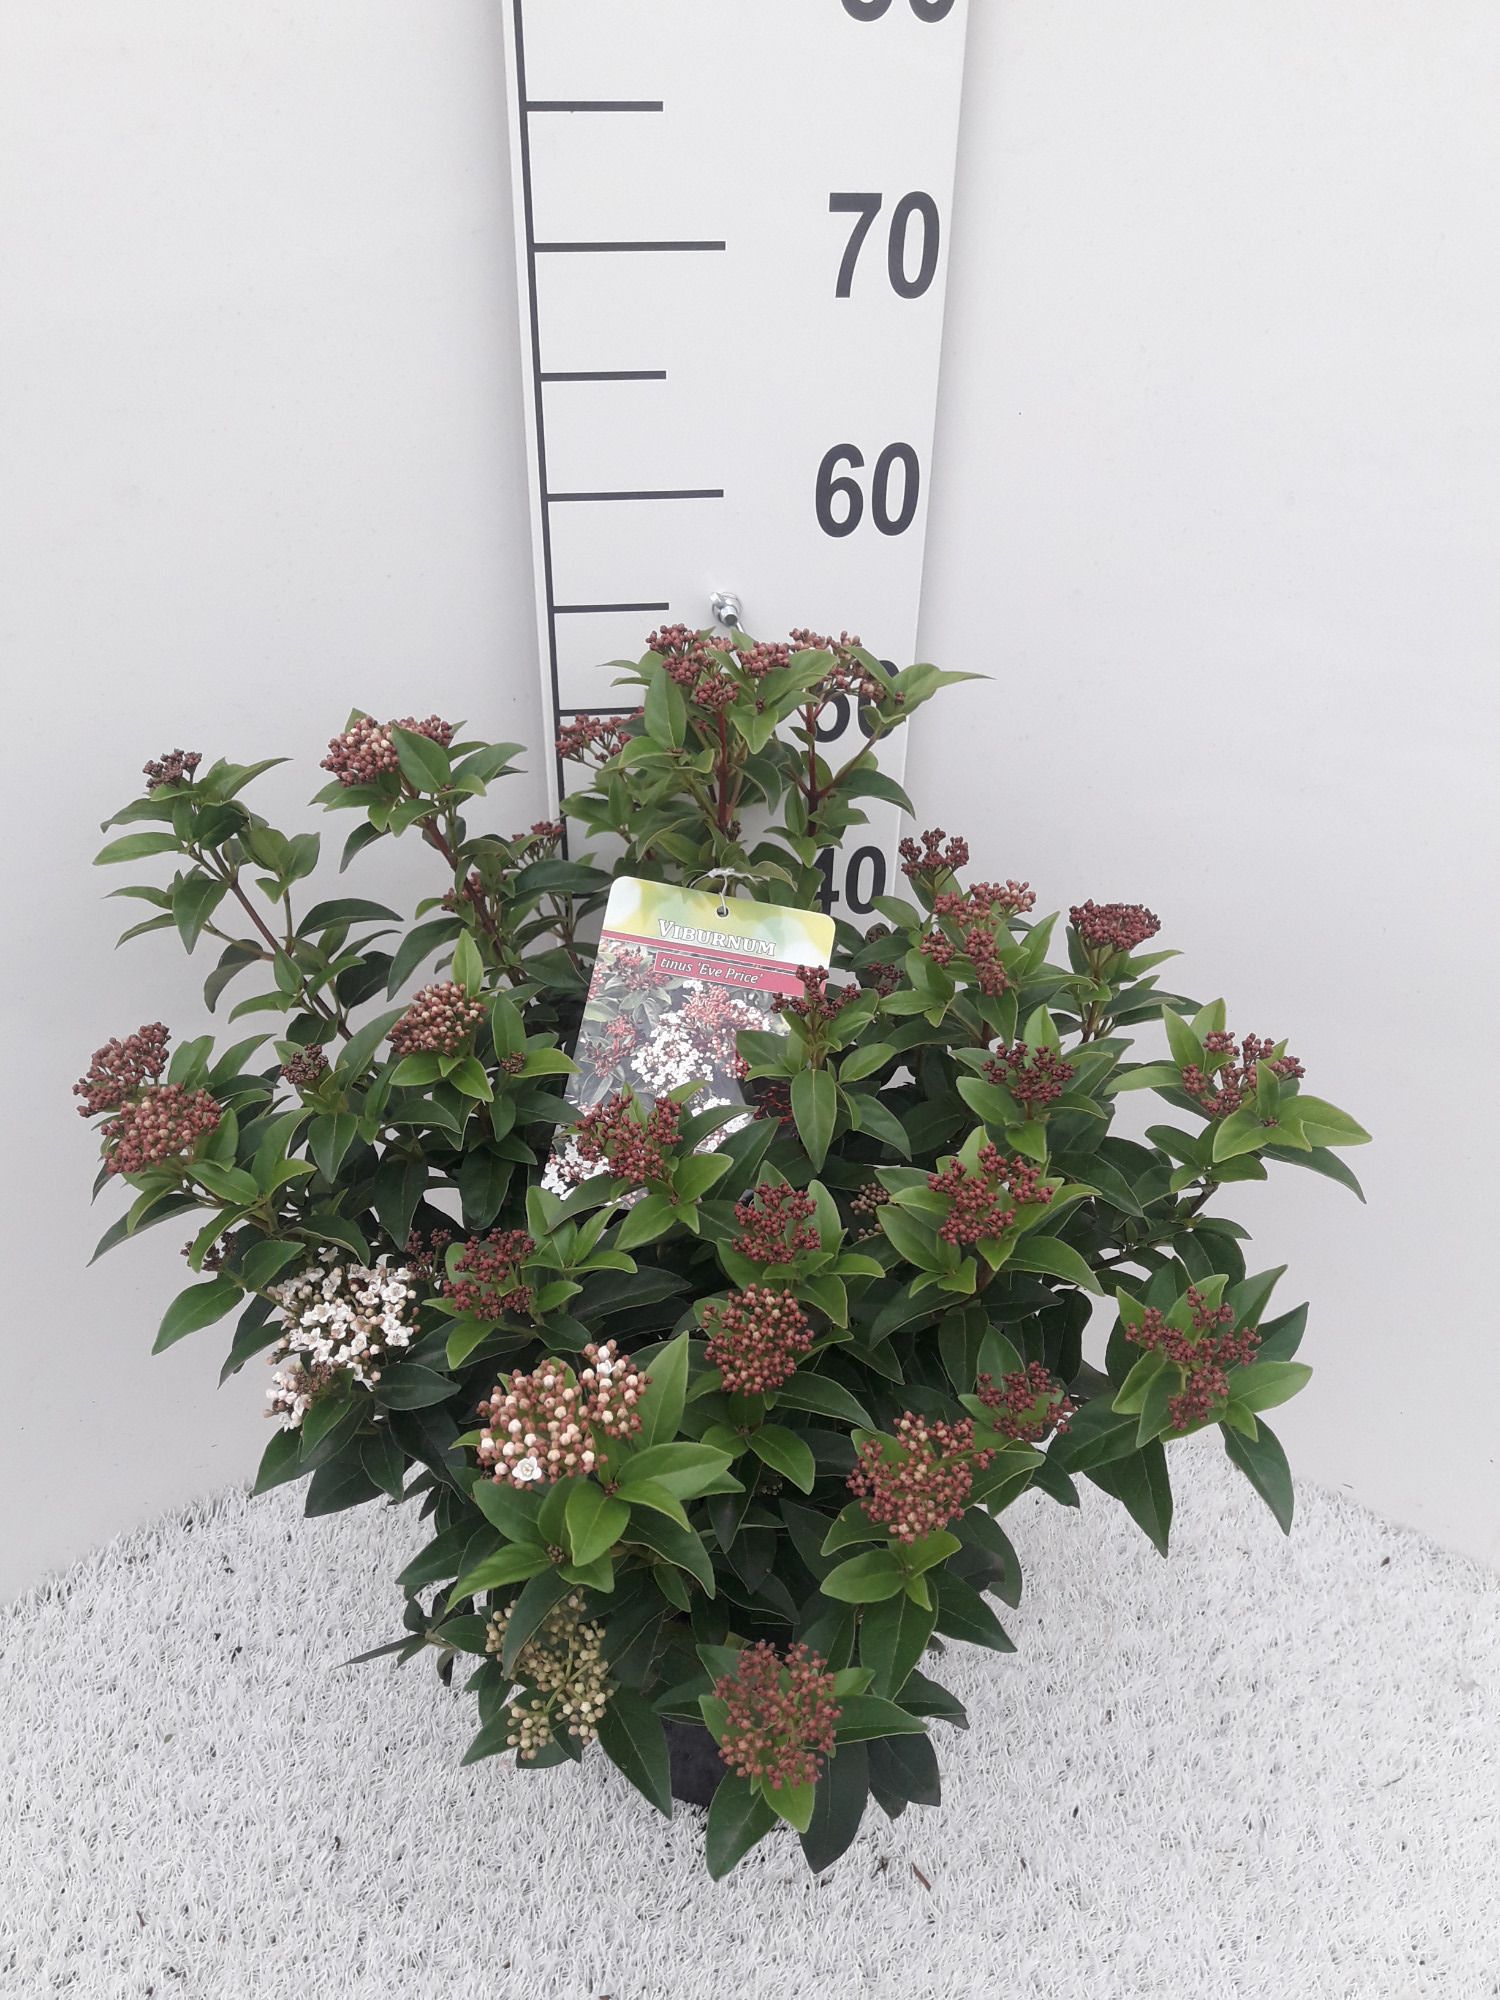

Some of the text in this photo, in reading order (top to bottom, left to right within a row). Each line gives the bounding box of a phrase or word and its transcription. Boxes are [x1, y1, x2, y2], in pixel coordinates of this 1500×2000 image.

[829, 191, 940, 299] 70
[815, 442, 920, 537] 60
[813, 845, 887, 915] 40
[658, 919, 776, 957] VIBURNUM
[660, 957, 693, 973] tinus
